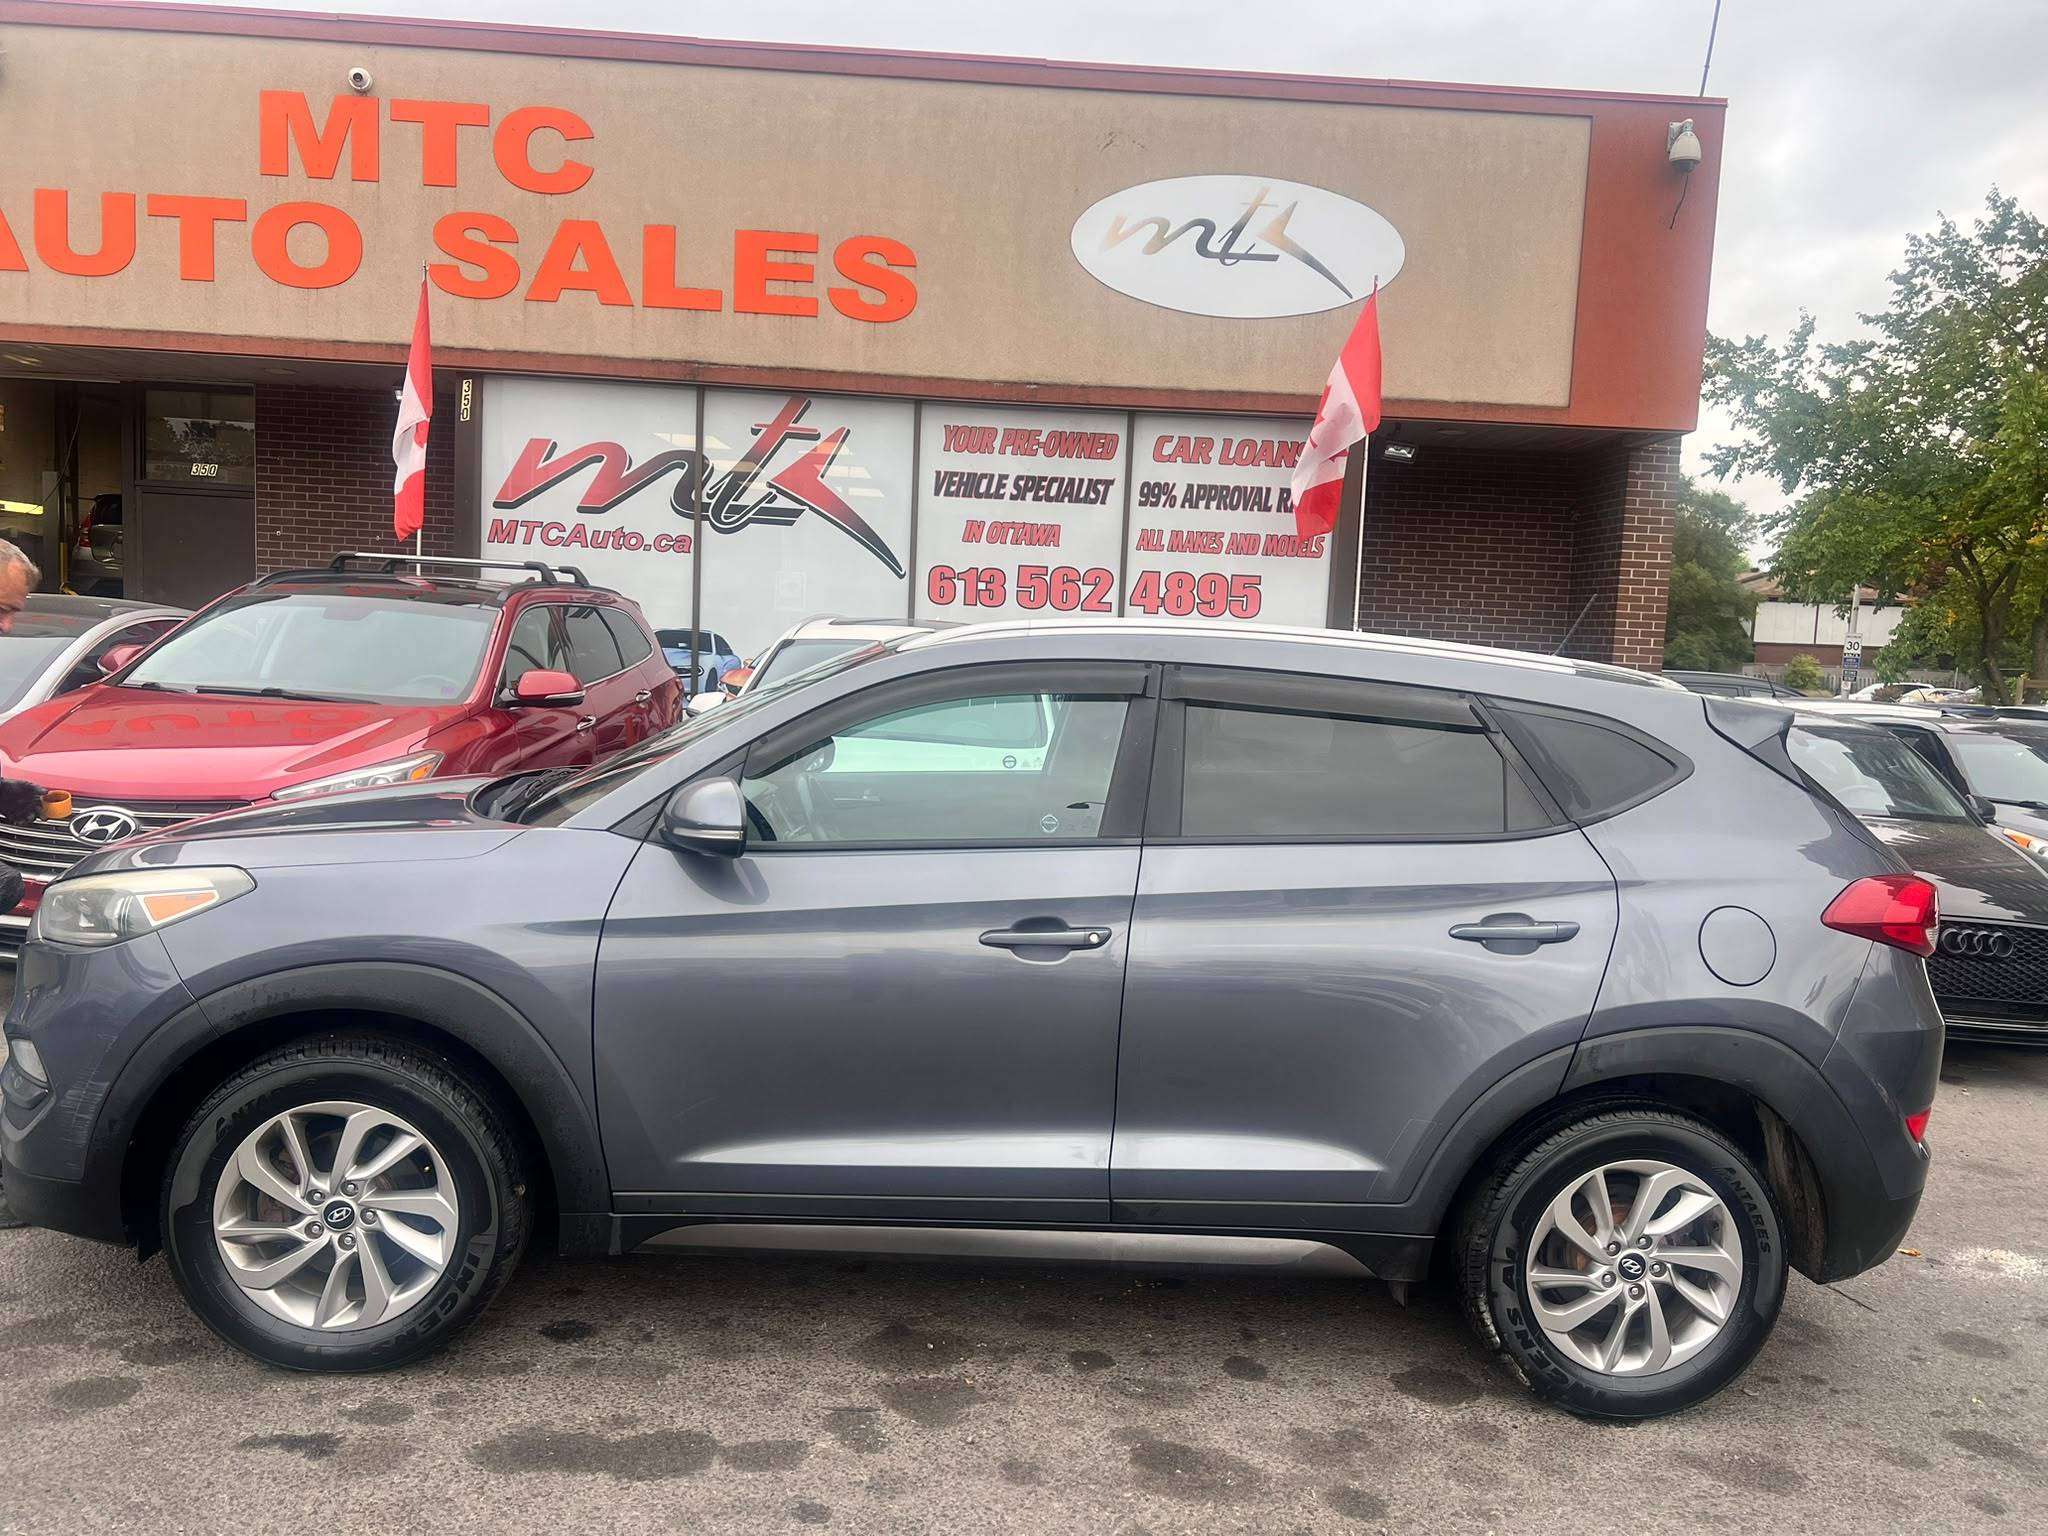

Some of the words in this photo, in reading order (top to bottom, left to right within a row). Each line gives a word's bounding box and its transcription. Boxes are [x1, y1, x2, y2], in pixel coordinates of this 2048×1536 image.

[258, 90, 594, 195] MTC
[0, 187, 363, 288] UTO
[429, 211, 918, 323] SALES
[462, 380, 471, 420] 350
[943, 424, 998, 454] YOUR
[999, 428, 1119, 460] PRE-OWNED
[1152, 435, 1216, 465] CAR
[191, 463, 218, 476] 350
[933, 470, 1010, 499] VEHICLE
[1009, 475, 1116, 505] SPECIALIST
[1138, 481, 1178, 508] 99%
[1180, 483, 1273, 512] APPROVAL
[487, 518, 693, 554] MTCAuto.ca
[962, 520, 985, 543] IN
[986, 521, 1062, 547] OTTAWA
[1136, 529, 1165, 551] ALL
[1167, 530, 1225, 554] MAKES
[1225, 533, 1261, 555] AND
[928, 565, 1006, 607] 613
[1016, 565, 1115, 612] 562
[1129, 570, 1262, 619] 4895
[1846, 641, 1860, 651] 30
